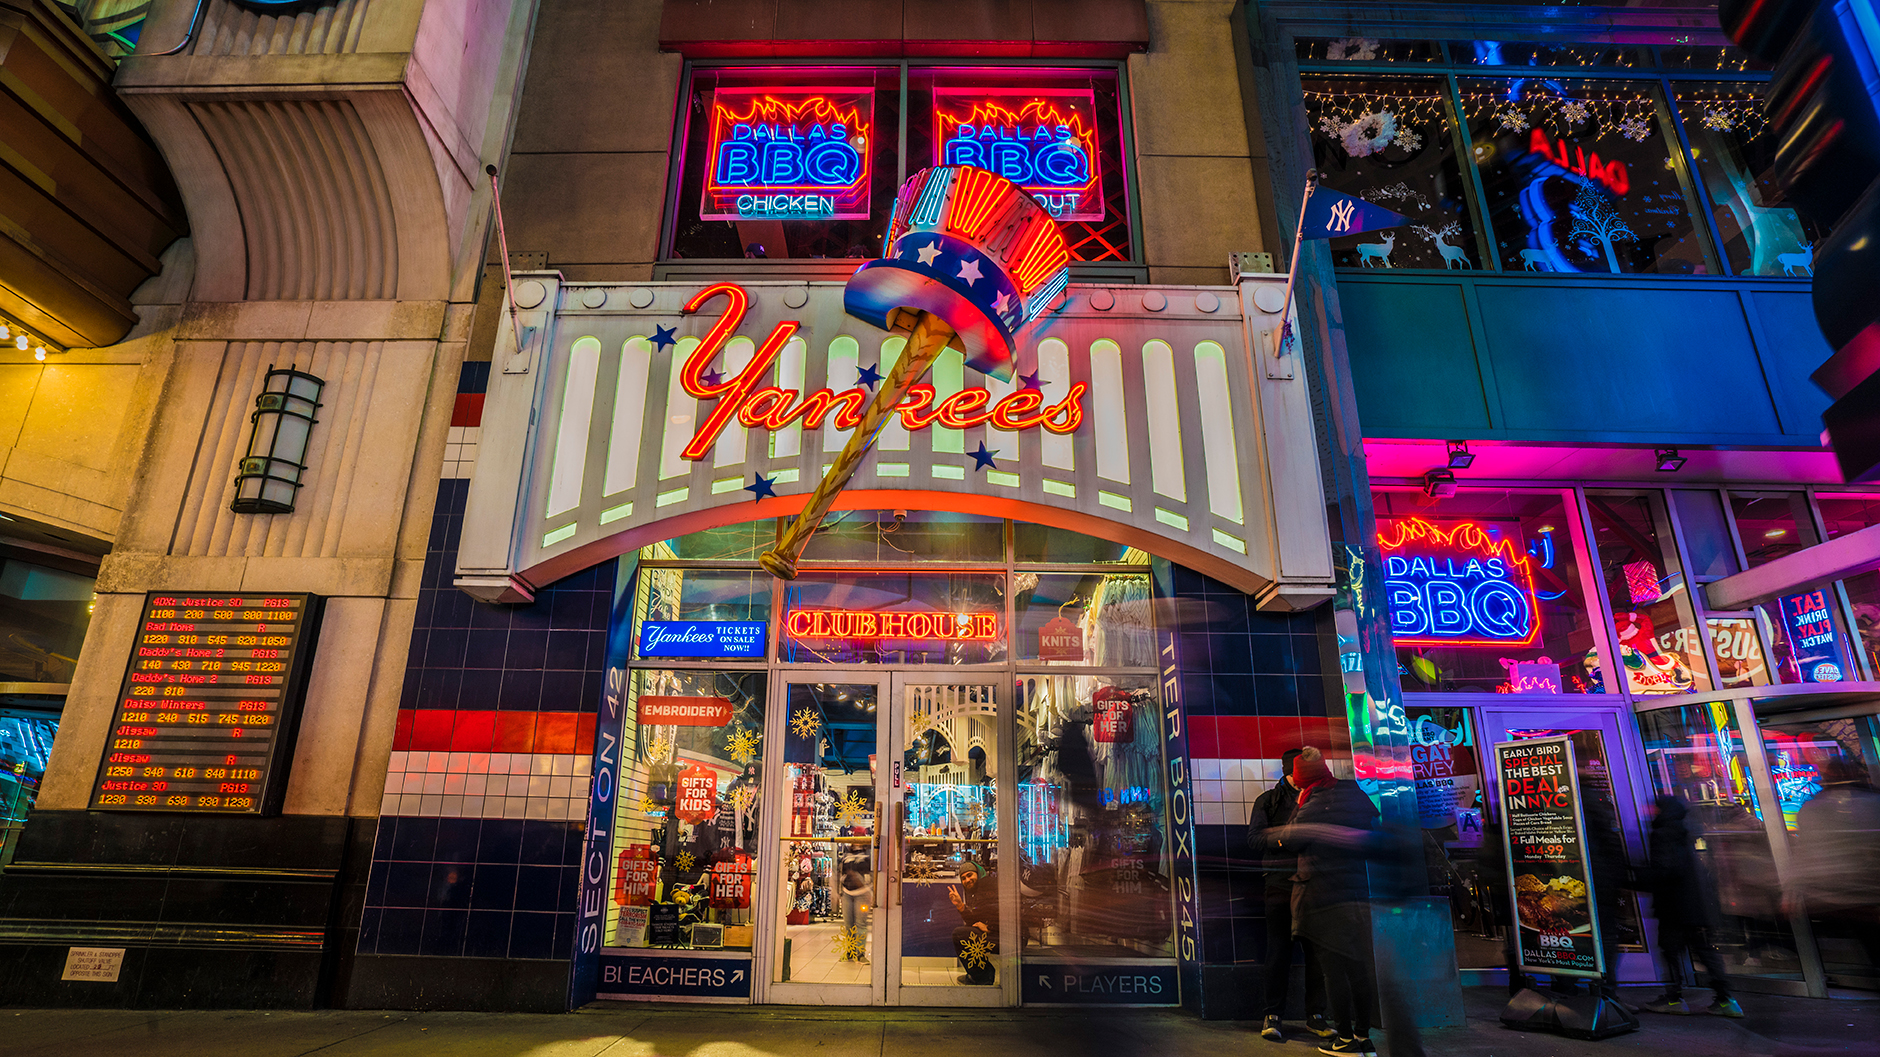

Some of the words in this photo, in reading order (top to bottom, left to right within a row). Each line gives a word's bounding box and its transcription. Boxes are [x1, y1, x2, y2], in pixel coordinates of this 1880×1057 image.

[733, 123, 847, 141] DALLAS
[958, 124, 1073, 141] DALLAS
[717, 140, 860, 185] BBQ
[945, 138, 1090, 185] BBQ
[737, 193, 834, 214] CHICKEN
[1325, 198, 1356, 233] NY
[1388, 556, 1505, 579] DALLAS
[153, 597, 177, 607] 4DX:
[182, 597, 225, 607] Justice
[228, 598, 243, 607] 3D
[263, 598, 290, 608] PG13
[1384, 579, 1530, 638] BBQ
[150, 609, 176, 619] 1100
[184, 610, 205, 619] 200
[213, 610, 235, 619] 500
[243, 611, 264, 620] 800
[267, 611, 293, 620] 1100
[146, 622, 167, 631] Bad
[169, 622, 195, 632] Moms
[257, 623, 267, 633] R
[716, 626, 760, 635] TICKETS
[142, 634, 170, 644] 1220
[207, 635, 228, 645] 545
[236, 636, 258, 645] 820
[261, 636, 288, 646] 1050
[645, 625, 715, 652] Yankees
[1041, 634, 1080, 648] KNITS
[138, 647, 182, 657] Daddy's
[186, 648, 212, 657] Home
[215, 648, 225, 658] 2
[251, 649, 278, 659] PG13
[723, 644, 750, 652] NOW!!
[142, 660, 163, 670] 140
[201, 661, 222, 671] 710
[231, 661, 252, 671] 945
[255, 662, 281, 672] 1220
[131, 672, 176, 682] Daddy's
[179, 674, 206, 683] Home
[209, 674, 218, 684] 2
[245, 675, 272, 685] PG13
[133, 686, 156, 696] 220
[163, 686, 186, 696] 810
[607, 666, 623, 719] 42
[1161, 631, 1181, 741] TIER
[123, 698, 157, 709] Daisy
[160, 699, 206, 710] Winters
[238, 700, 267, 711] PG13
[644, 704, 723, 718] EMBROIDERY
[1097, 700, 1129, 711] GIFTS
[121, 712, 150, 722] 1210
[157, 712, 180, 723] 240
[187, 713, 210, 724] 515
[218, 713, 240, 724] 745
[243, 714, 270, 724] 1020
[1102, 710, 1124, 721] FOR
[232, 727, 243, 738] R
[1100, 721, 1127, 733] HER
[113, 739, 143, 749] 1210
[1410, 742, 1452, 764] GAT
[1503, 747, 1534, 759] EARLY
[1536, 745, 1561, 755] BIRD
[226, 754, 237, 765] R
[1504, 754, 1563, 770] SPECIAL
[106, 766, 135, 777] 1250
[142, 766, 166, 777] 340
[173, 767, 197, 778] 610
[204, 768, 227, 779] 840
[230, 769, 258, 779] 1110
[1412, 760, 1454, 779] RVEY
[1505, 767, 1530, 779] THE
[1531, 764, 1563, 776] BEST
[101, 780, 149, 791] Justice
[151, 781, 169, 791] 3D
[219, 782, 249, 794] PG13
[681, 777, 713, 788] GIFTS
[685, 788, 707, 799] FOR
[98, 794, 128, 805] 1230
[135, 795, 158, 805] 330
[166, 795, 190, 806] 630
[198, 796, 220, 807] 930
[223, 797, 252, 807] 1230
[679, 798, 712, 812] KIDS
[1508, 795, 1527, 810] IN
[1527, 793, 1569, 809] NYC
[1170, 756, 1191, 860] BOX
[1462, 812, 1479, 832] A
[1511, 835, 1519, 844] 2
[1520, 835, 1535, 844] Full
[1535, 834, 1562, 844] Meals
[1562, 834, 1576, 844] for
[1524, 844, 1564, 855] $14.99
[622, 860, 654, 871] GIFTS
[715, 862, 748, 873] GIFTS
[1111, 858, 1144, 870] GIFTS
[625, 871, 648, 882] FOR
[719, 873, 742, 884] FOR
[1117, 870, 1139, 881] FOR
[622, 882, 649, 896] HIM
[715, 884, 744, 898] HER
[1113, 881, 1142, 894] HIM
[1176, 876, 1196, 962] 245
[1539, 934, 1574, 949] BBQ
[1524, 949, 1594, 962] DALLASBBQ.COM
[1064, 975, 1162, 994] PLAYERS
